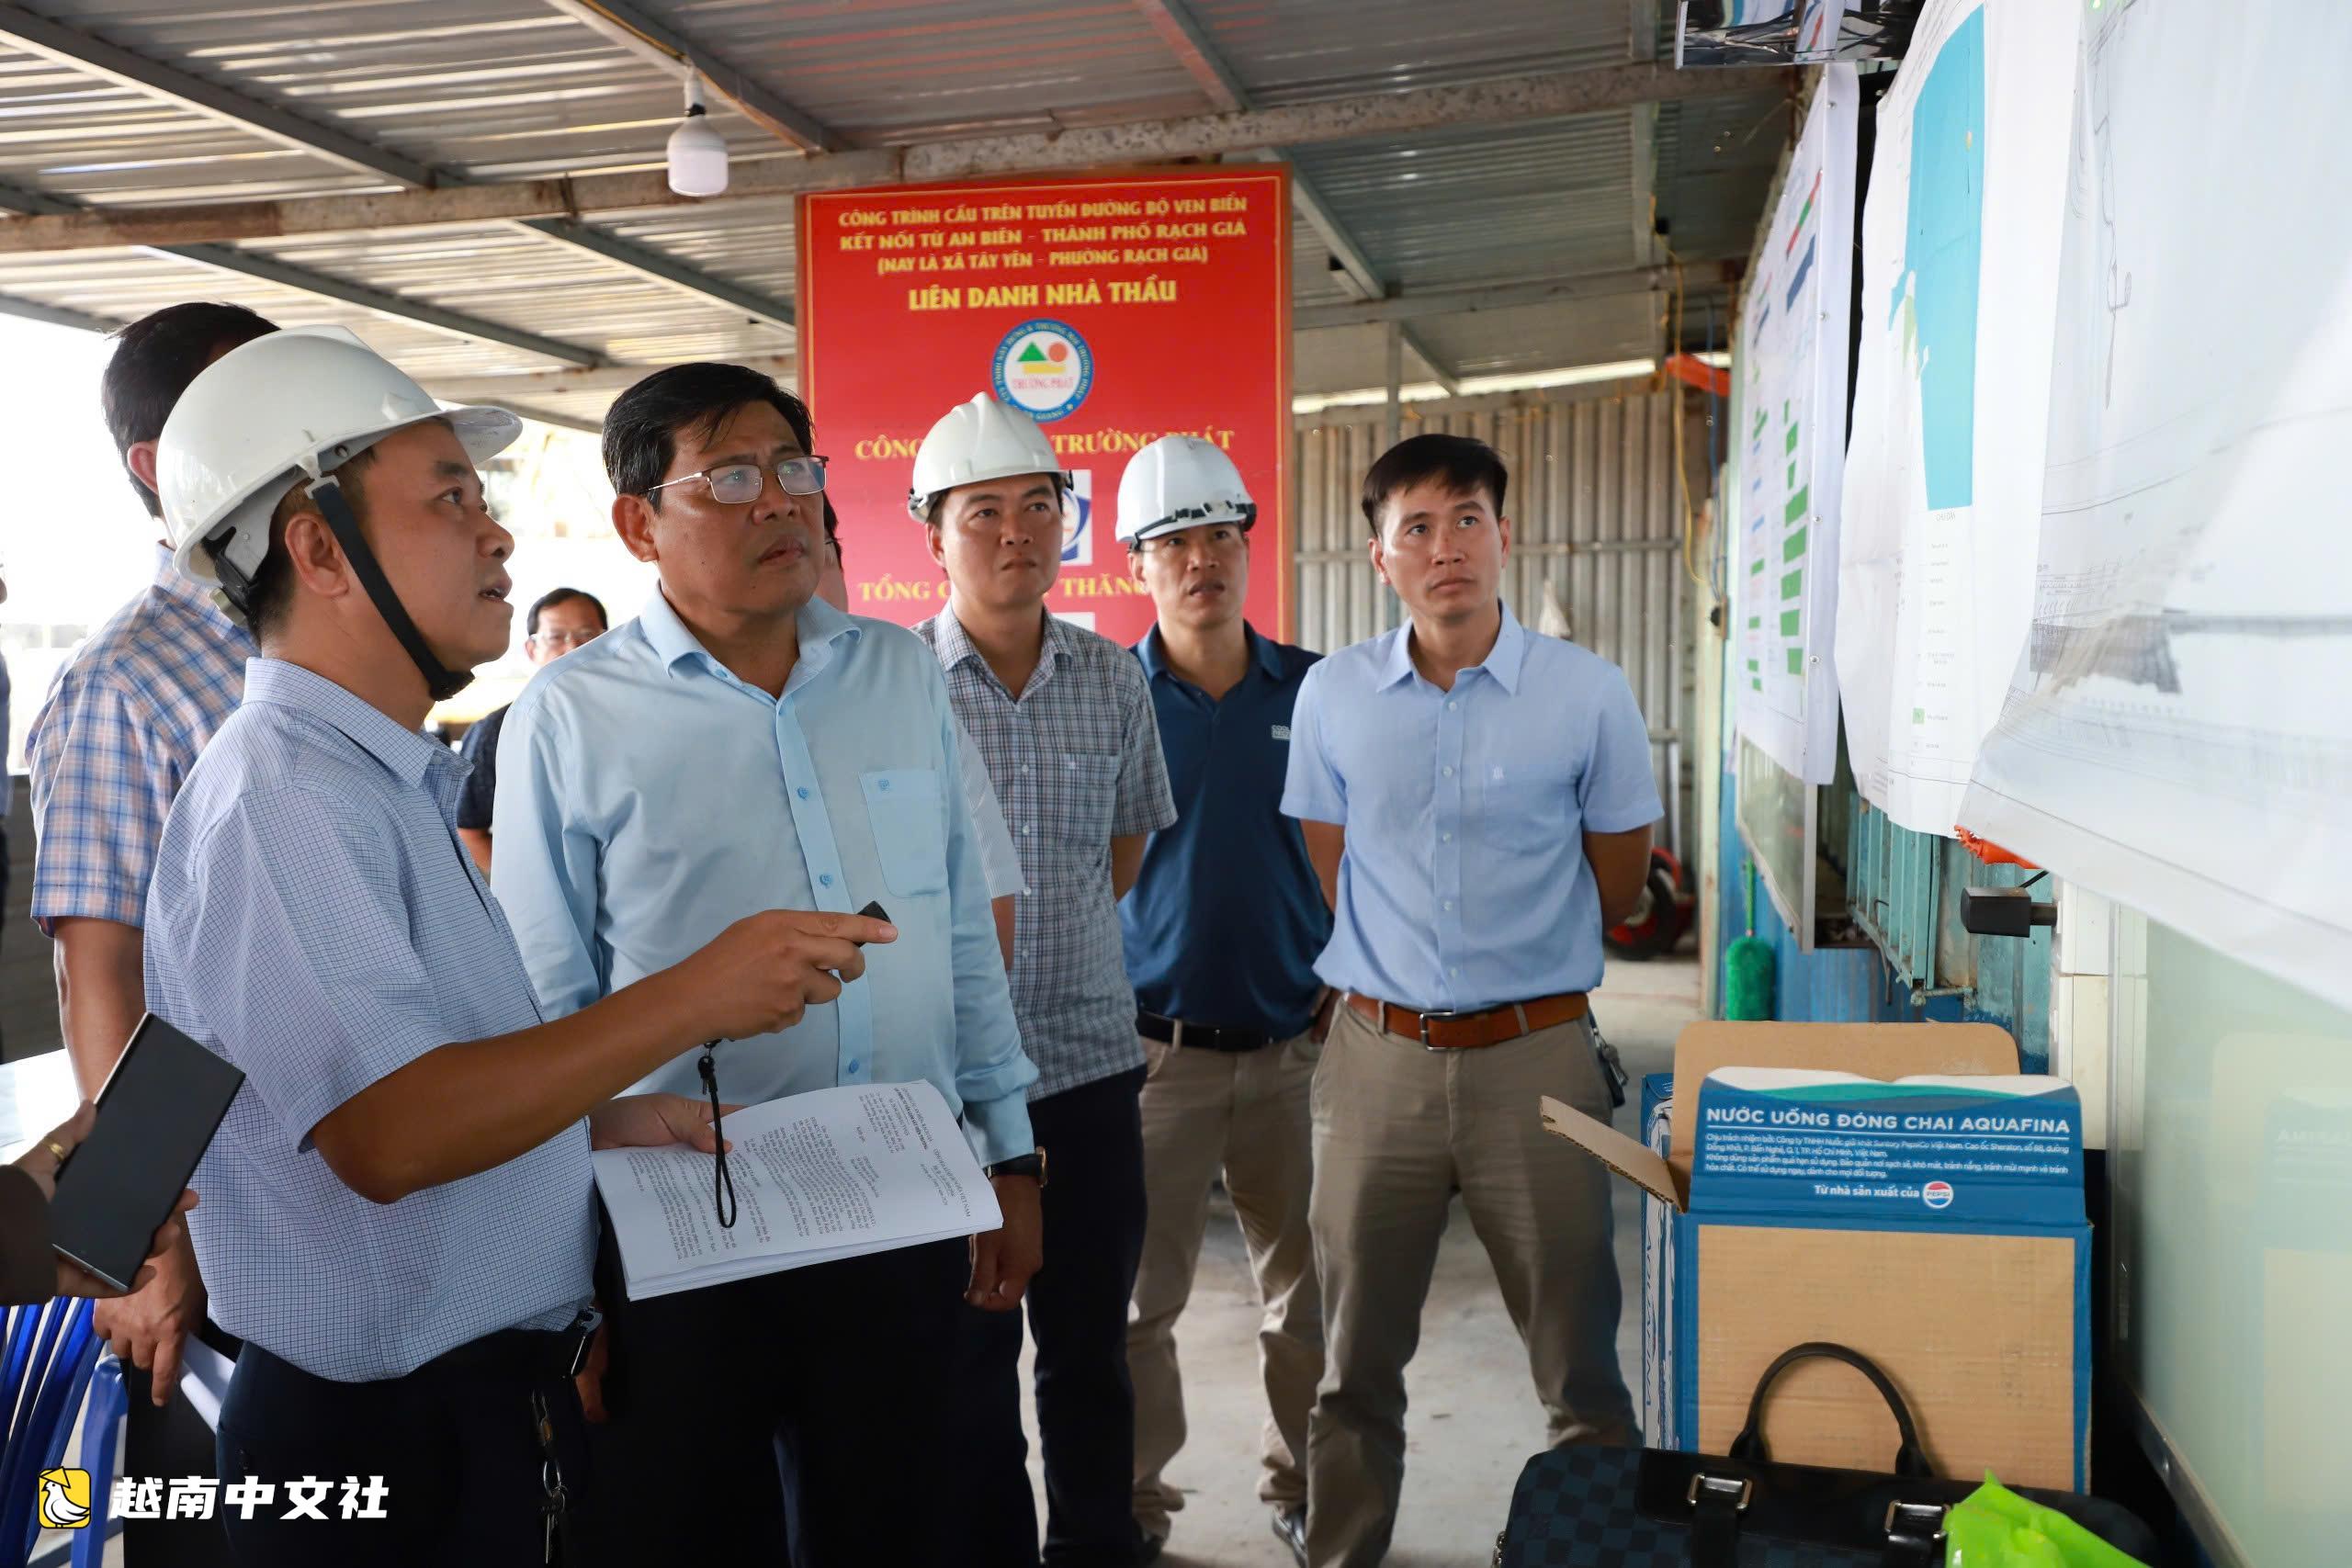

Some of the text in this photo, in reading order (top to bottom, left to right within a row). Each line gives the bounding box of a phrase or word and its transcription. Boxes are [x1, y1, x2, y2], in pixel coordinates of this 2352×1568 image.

[839, 209, 887, 227] CÔNG
[891, 209, 941, 225] TRÌNH
[981, 203, 1023, 220] TRÊN
[1145, 196, 1170, 217] BỘ
[1173, 198, 1206, 214] VEN
[840, 231, 874, 250] KẾT
[878, 230, 915, 249] NỐI
[948, 231, 976, 246] AN
[1042, 224, 1106, 243] THÀNH
[1112, 222, 1151, 241] PHỐ
[1156, 222, 1207, 240] RẠCH
[1212, 218, 1248, 235] GIÁ
[878, 256, 916, 276] (NAY
[920, 254, 939, 270] LÀ
[942, 253, 966, 270] XÃ
[1002, 250, 1033, 268] YÊN
[1123, 248, 1169, 265] RẠCH
[909, 284, 961, 310] LIÊN
[967, 284, 1040, 309] DANH
[1046, 278, 1102, 305] NHÀ
[1166, 424, 1235, 451] ÁT
[859, 572, 930, 602] TỔNG
[1706, 1106, 2070, 1134] NƯỚC UỐNG ĐÓNG CHAI AQUAFINA
[1815, 1184, 1920, 1198] Từ nhà sản xuất của
